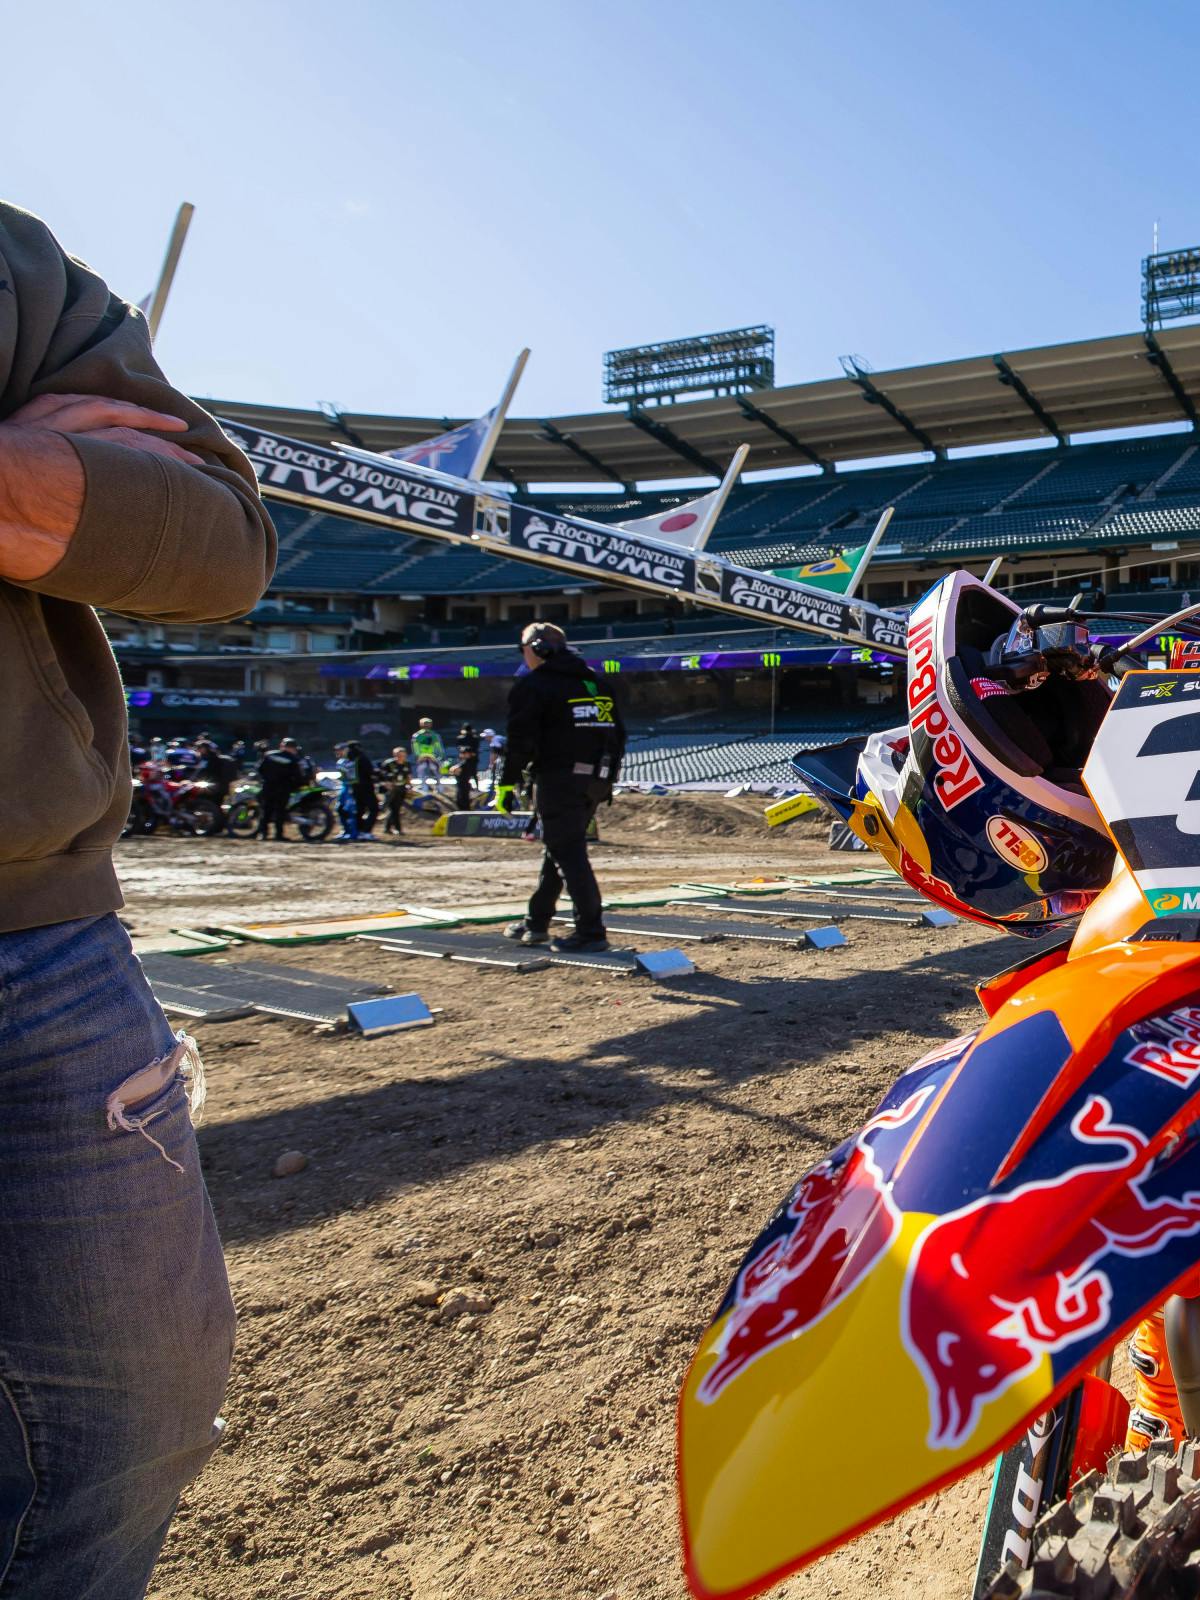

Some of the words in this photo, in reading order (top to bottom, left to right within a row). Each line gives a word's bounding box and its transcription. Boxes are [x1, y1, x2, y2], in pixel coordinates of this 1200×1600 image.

[255, 435, 338, 473] ROCKY
[339, 460, 460, 507] MOUNTAIN
[256, 460, 343, 494] TV
[552, 521, 607, 550] ROCKY
[608, 537, 685, 569] MOUNTAIN
[751, 579, 786, 599] ROCKY
[788, 590, 843, 615] MOUNTAIN
[908, 614, 937, 714] Bull
[572, 701, 614, 722] SMX
[1140, 683, 1176, 698] SMX
[911, 699, 985, 813] Red
[994, 820, 1041, 871] BELL
